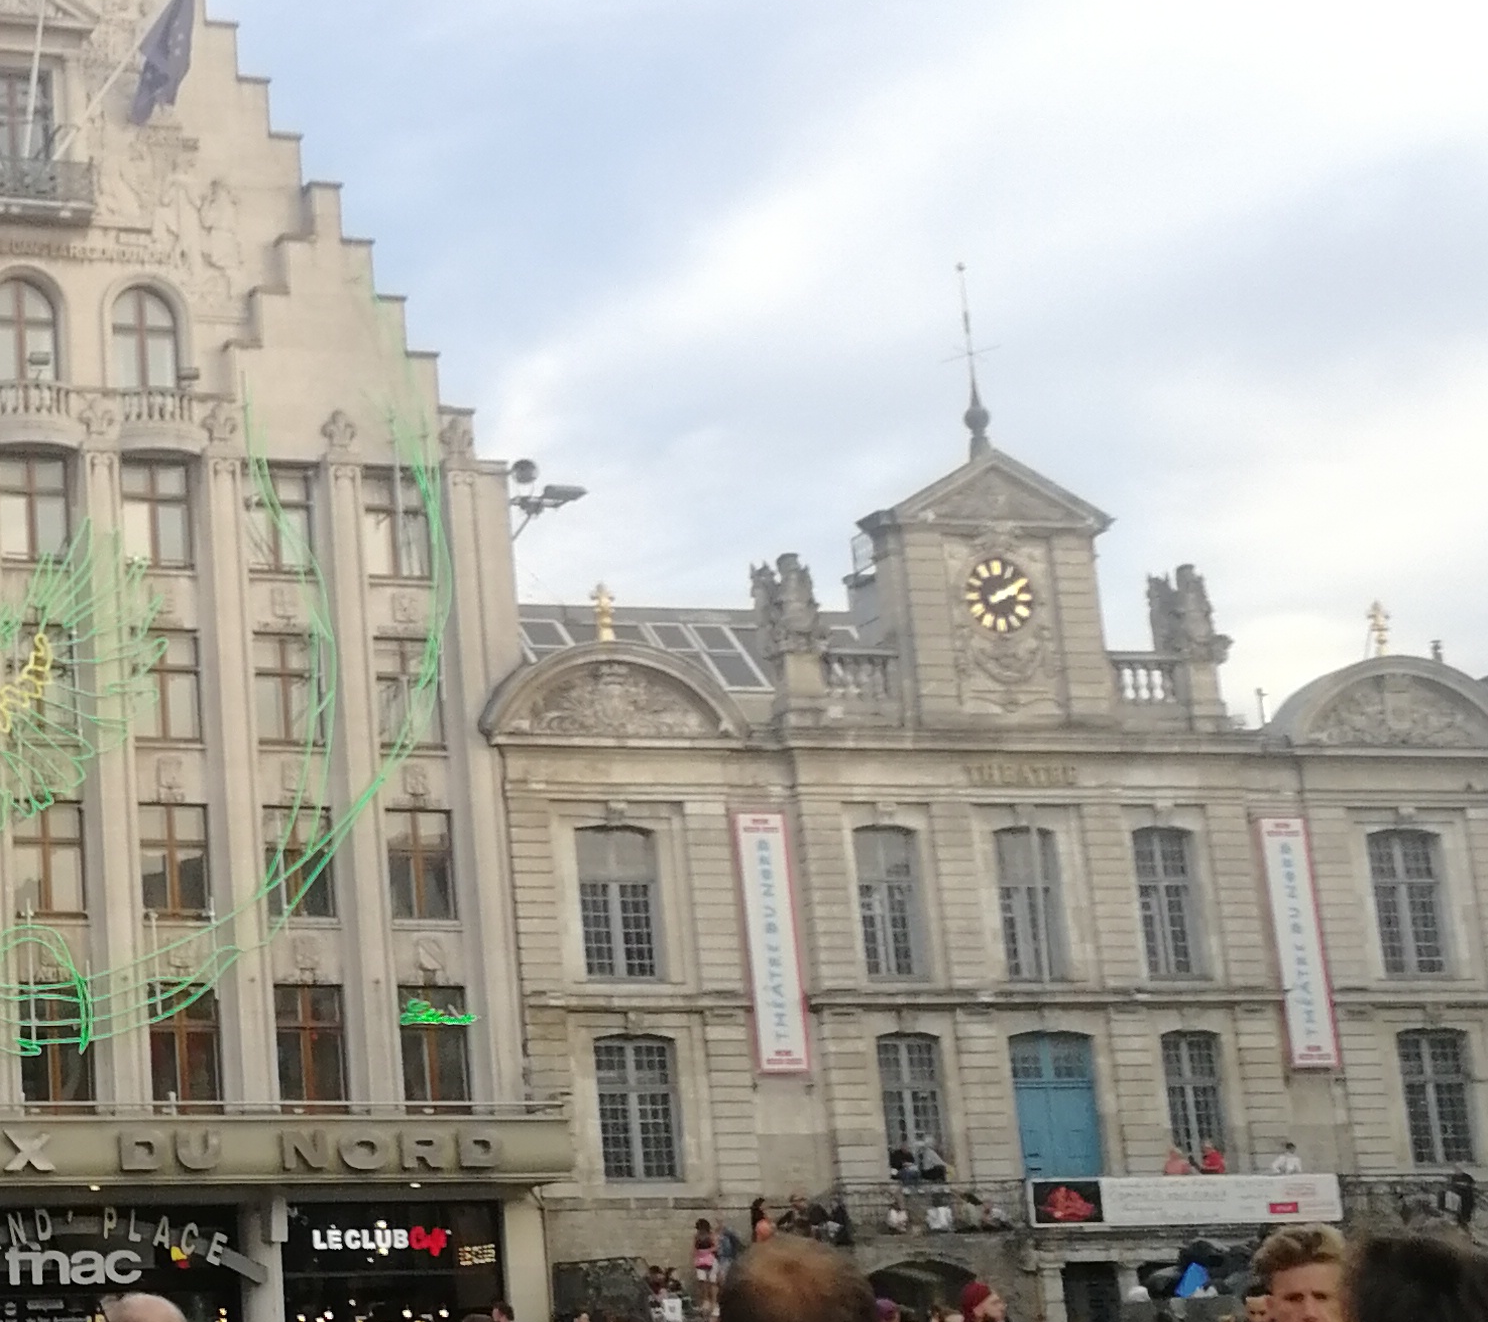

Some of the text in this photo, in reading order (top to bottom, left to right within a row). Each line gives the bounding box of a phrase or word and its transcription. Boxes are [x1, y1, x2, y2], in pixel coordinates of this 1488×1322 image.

[118, 1129, 219, 1172] DU
[279, 1129, 503, 1172] NORD
[103, 1207, 229, 1266] PLACE
[5, 1240, 143, 1286] fnac
